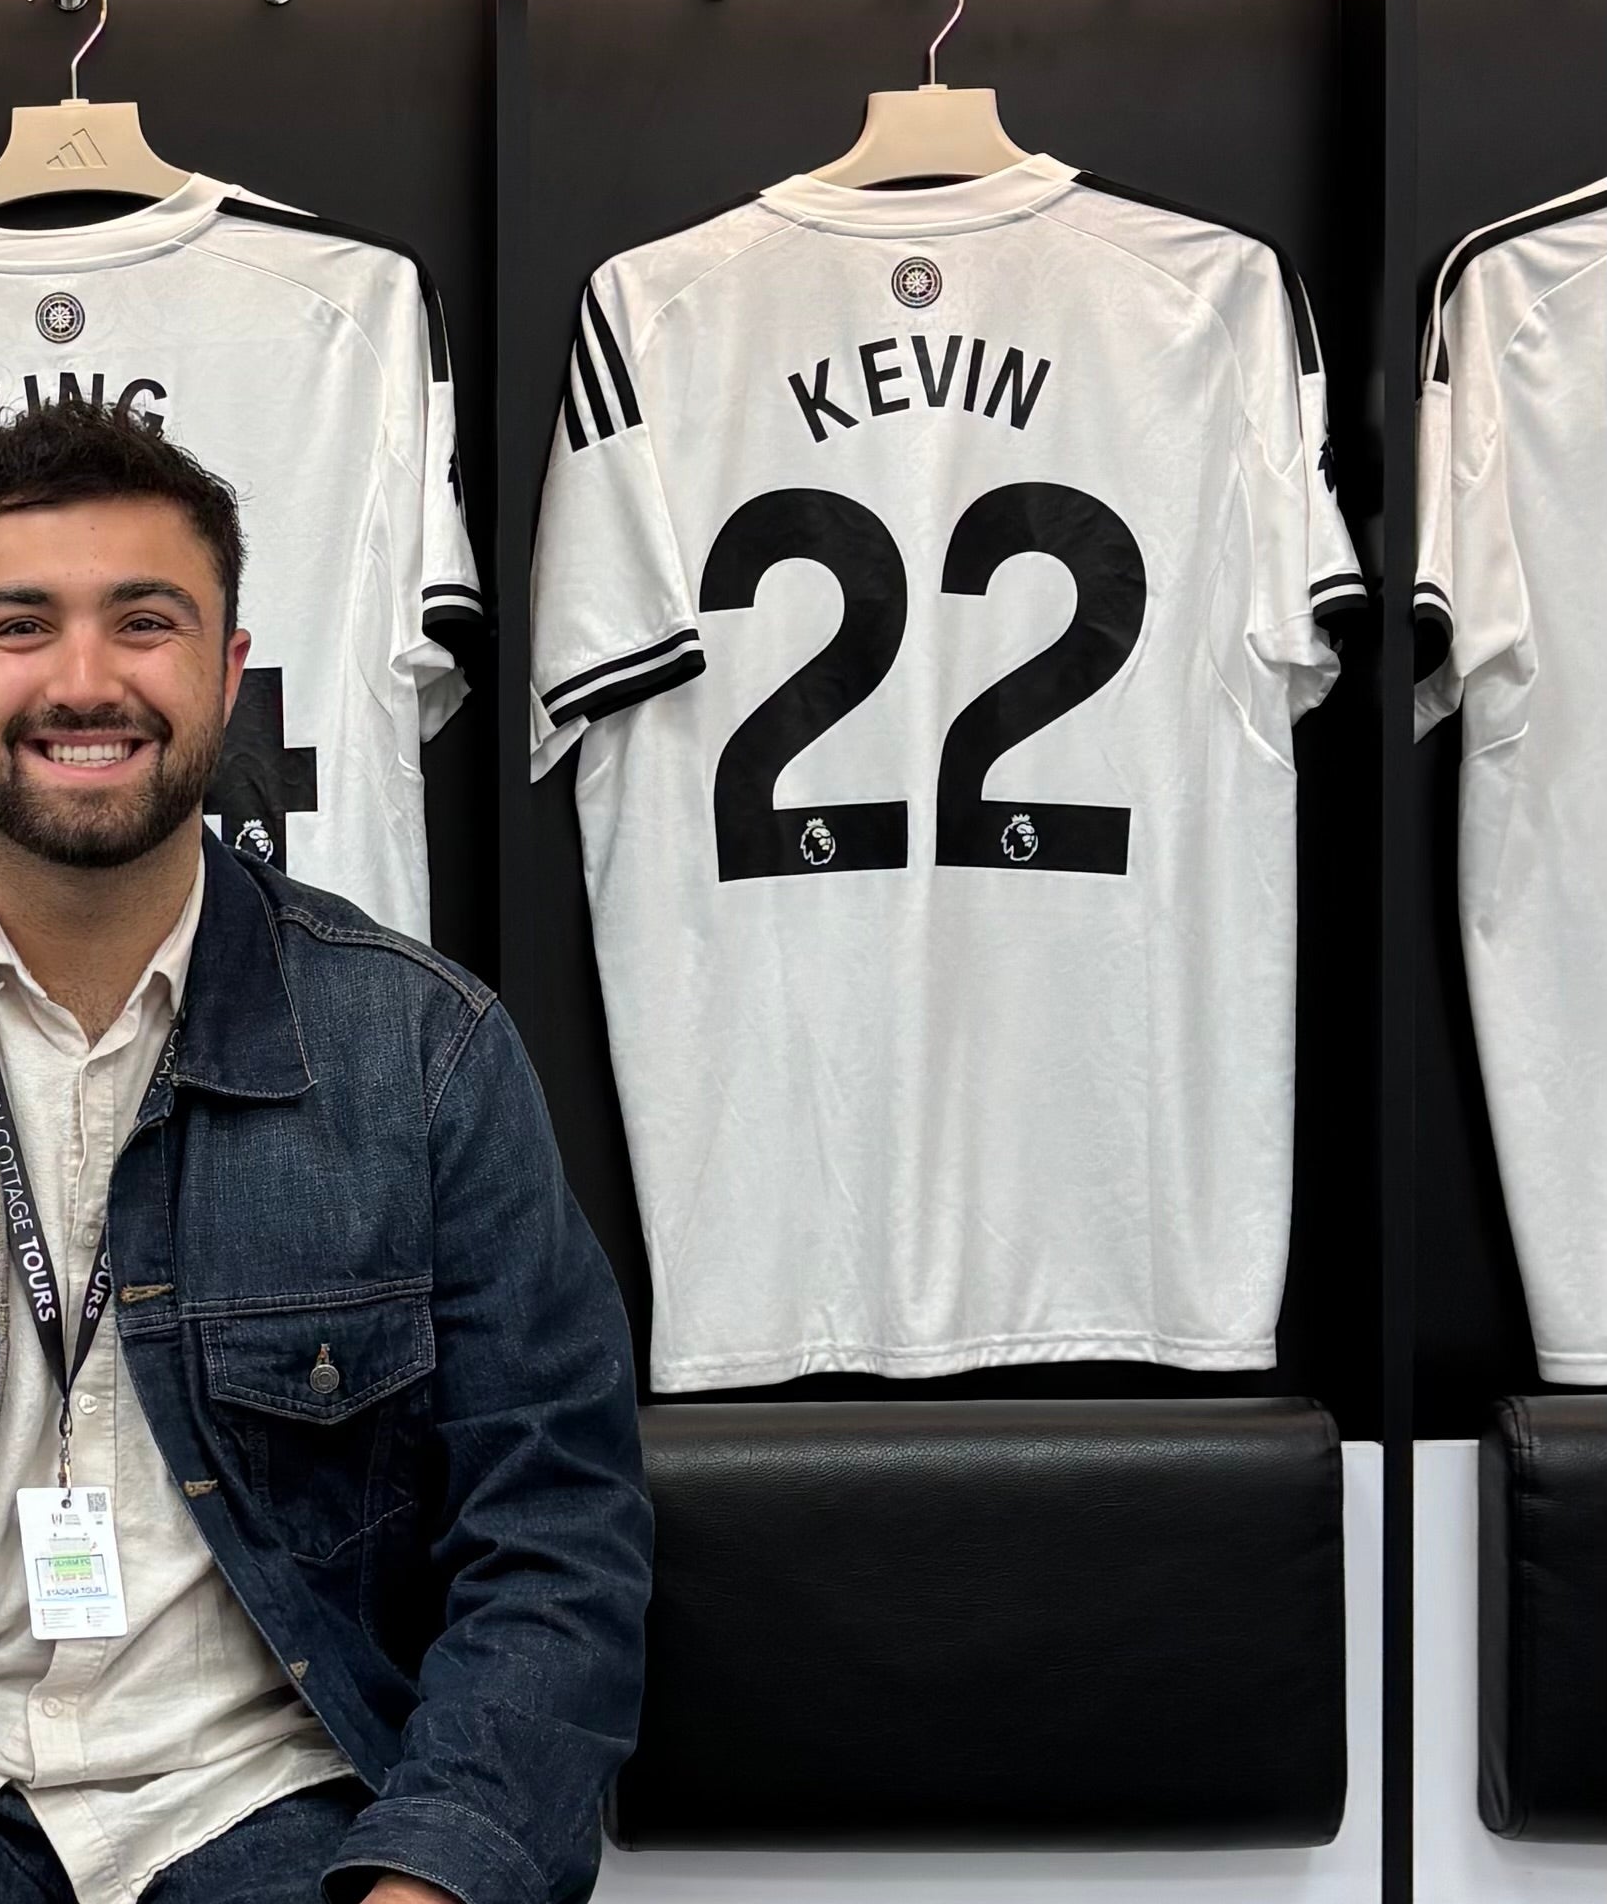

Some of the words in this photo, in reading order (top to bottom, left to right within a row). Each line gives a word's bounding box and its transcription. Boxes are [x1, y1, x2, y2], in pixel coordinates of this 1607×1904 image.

[787, 334, 1052, 444] KEVIN
[698, 480, 1149, 883] 22
[18, 1235, 56, 1322] TOURS
